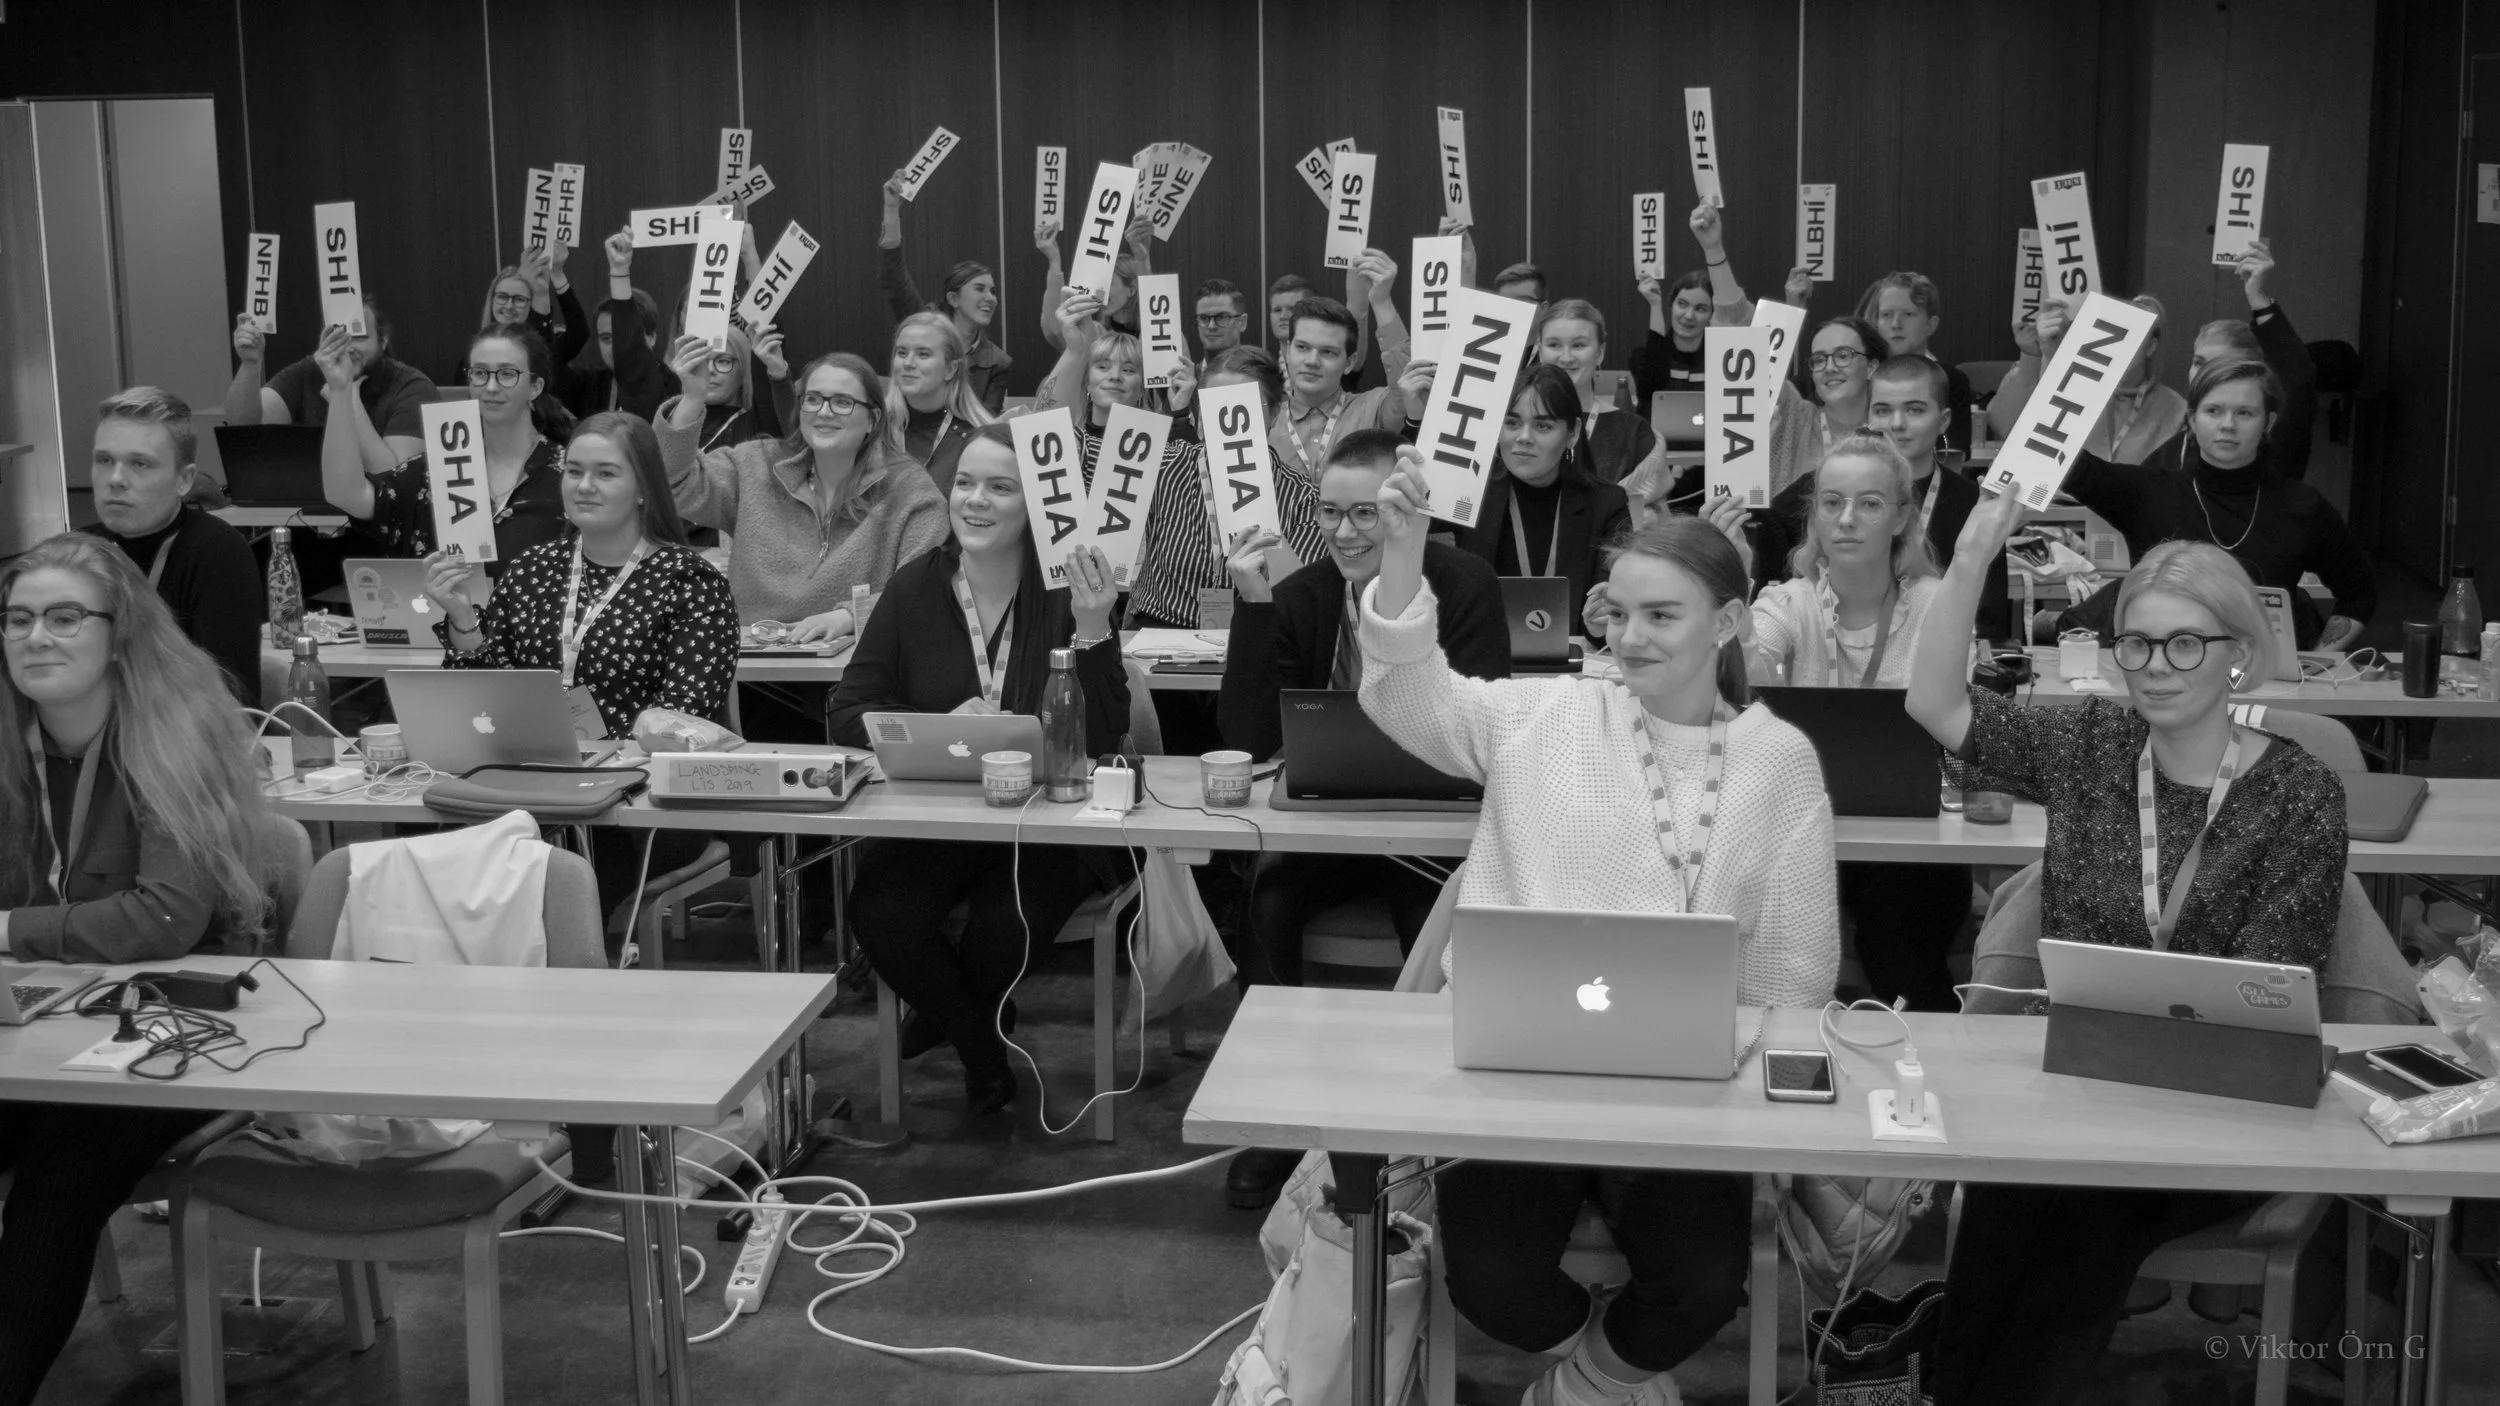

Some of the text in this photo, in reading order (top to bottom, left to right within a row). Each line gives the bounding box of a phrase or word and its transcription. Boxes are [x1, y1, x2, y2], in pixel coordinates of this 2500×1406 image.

[726, 133, 744, 186] SFH
[905, 134, 951, 184] SFHR
[1042, 151, 1060, 216] SFHR
[557, 179, 576, 242] SFHR
[648, 211, 701, 237] SHÍ
[1085, 188, 1121, 263] SHÍ
[1152, 166, 1194, 228] SÍNE
[1338, 173, 1363, 235] SHÍ
[1641, 198, 1656, 264] SFHR
[2227, 166, 2255, 230] SHÍ
[327, 227, 356, 296] SHÍ
[1803, 200, 1825, 277] NLBHÍ
[2045, 221, 2088, 295] SHÍ
[253, 238, 273, 317] NFHB
[698, 242, 729, 311] SHÍ
[754, 252, 793, 312] SHÍ
[1149, 294, 1177, 352] SHÍ
[1433, 314, 1512, 477] NLHÍ
[1722, 348, 1755, 464] SHA
[2024, 318, 2129, 467] NLHÍ
[440, 420, 478, 525] SHA
[1031, 432, 1078, 545] SHA
[1097, 428, 1152, 536] SHA
[1219, 404, 1261, 512] SHA
[1294, 703, 1325, 711] YOGA
